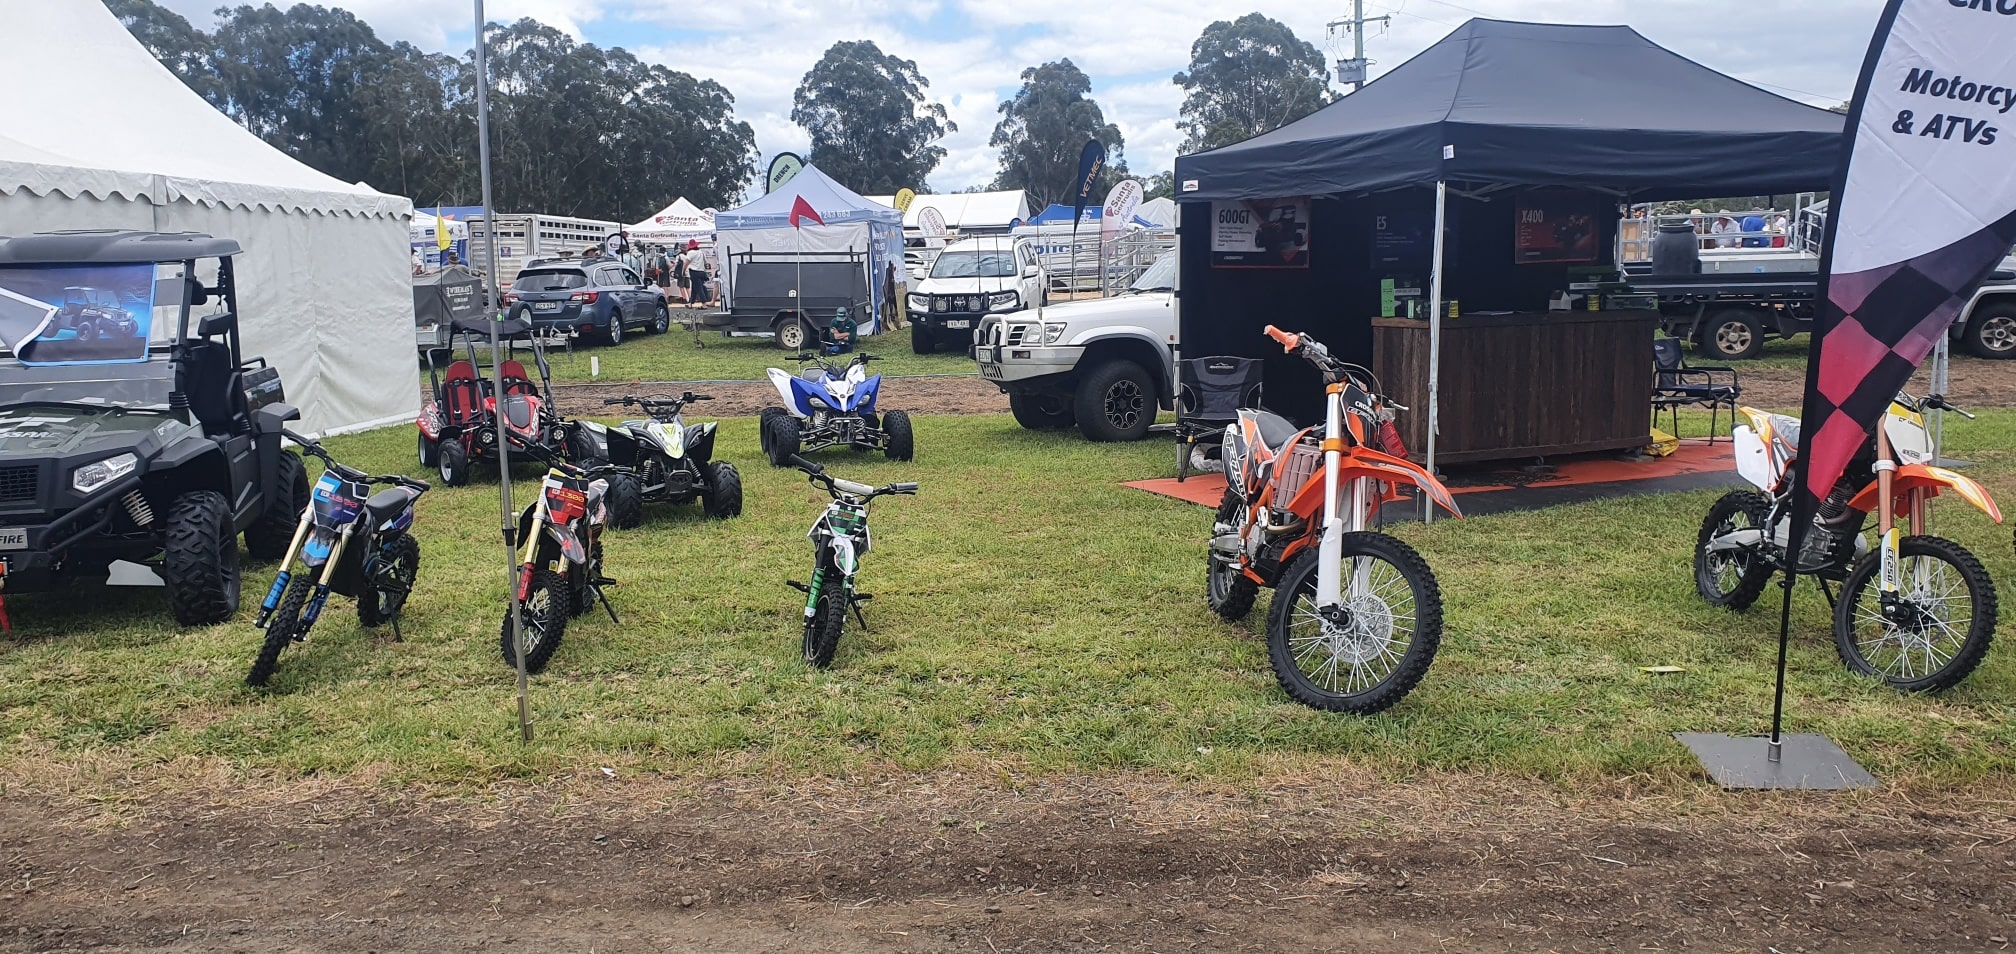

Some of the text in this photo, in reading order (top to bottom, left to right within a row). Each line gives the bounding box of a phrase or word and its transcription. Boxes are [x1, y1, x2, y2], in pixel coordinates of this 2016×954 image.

[1891, 109, 1999, 146] & ATVs
[772, 163, 791, 184] DRENCH
[1111, 181, 1131, 208] Santa
[1113, 185, 1136, 216] Gertrudis
[1218, 208, 1250, 225] 600GT
[1376, 215, 1387, 230] E5
[1521, 209, 1544, 224] X400
